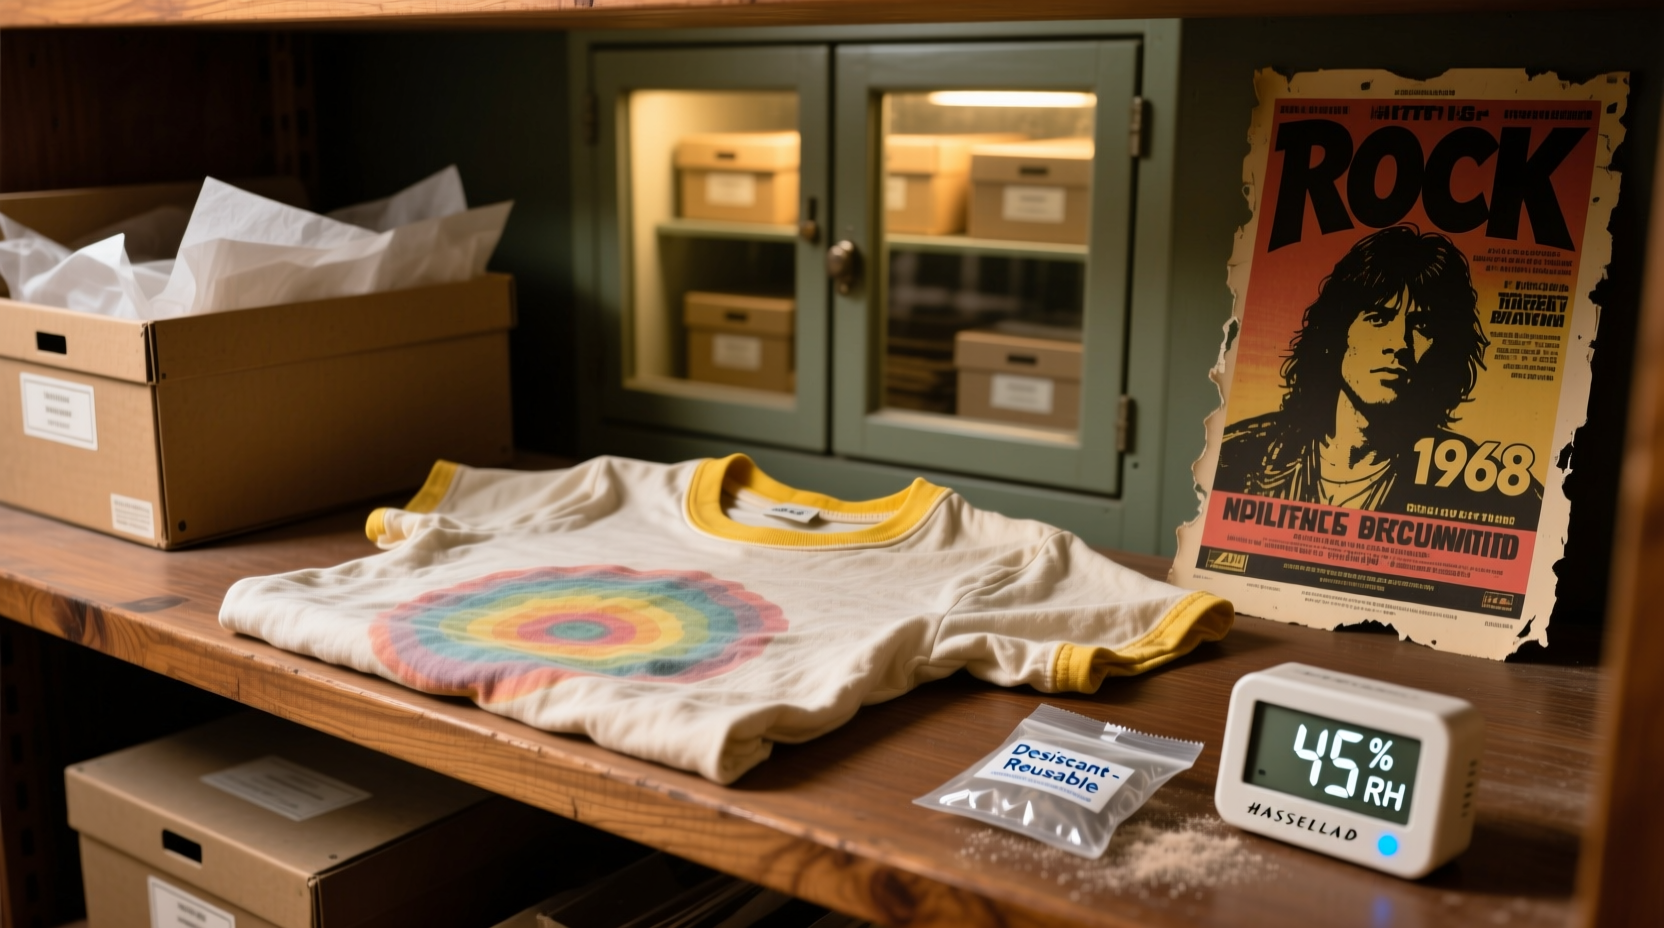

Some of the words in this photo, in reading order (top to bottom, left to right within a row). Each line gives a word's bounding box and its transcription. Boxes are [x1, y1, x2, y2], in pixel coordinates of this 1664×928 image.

[1268, 119, 1591, 254] ROCK
[1413, 437, 1535, 496] 1968
[1293, 723, 1364, 799] 45
[1247, 801, 1358, 841] HASSELLAD
[1363, 775, 1406, 812] RH
